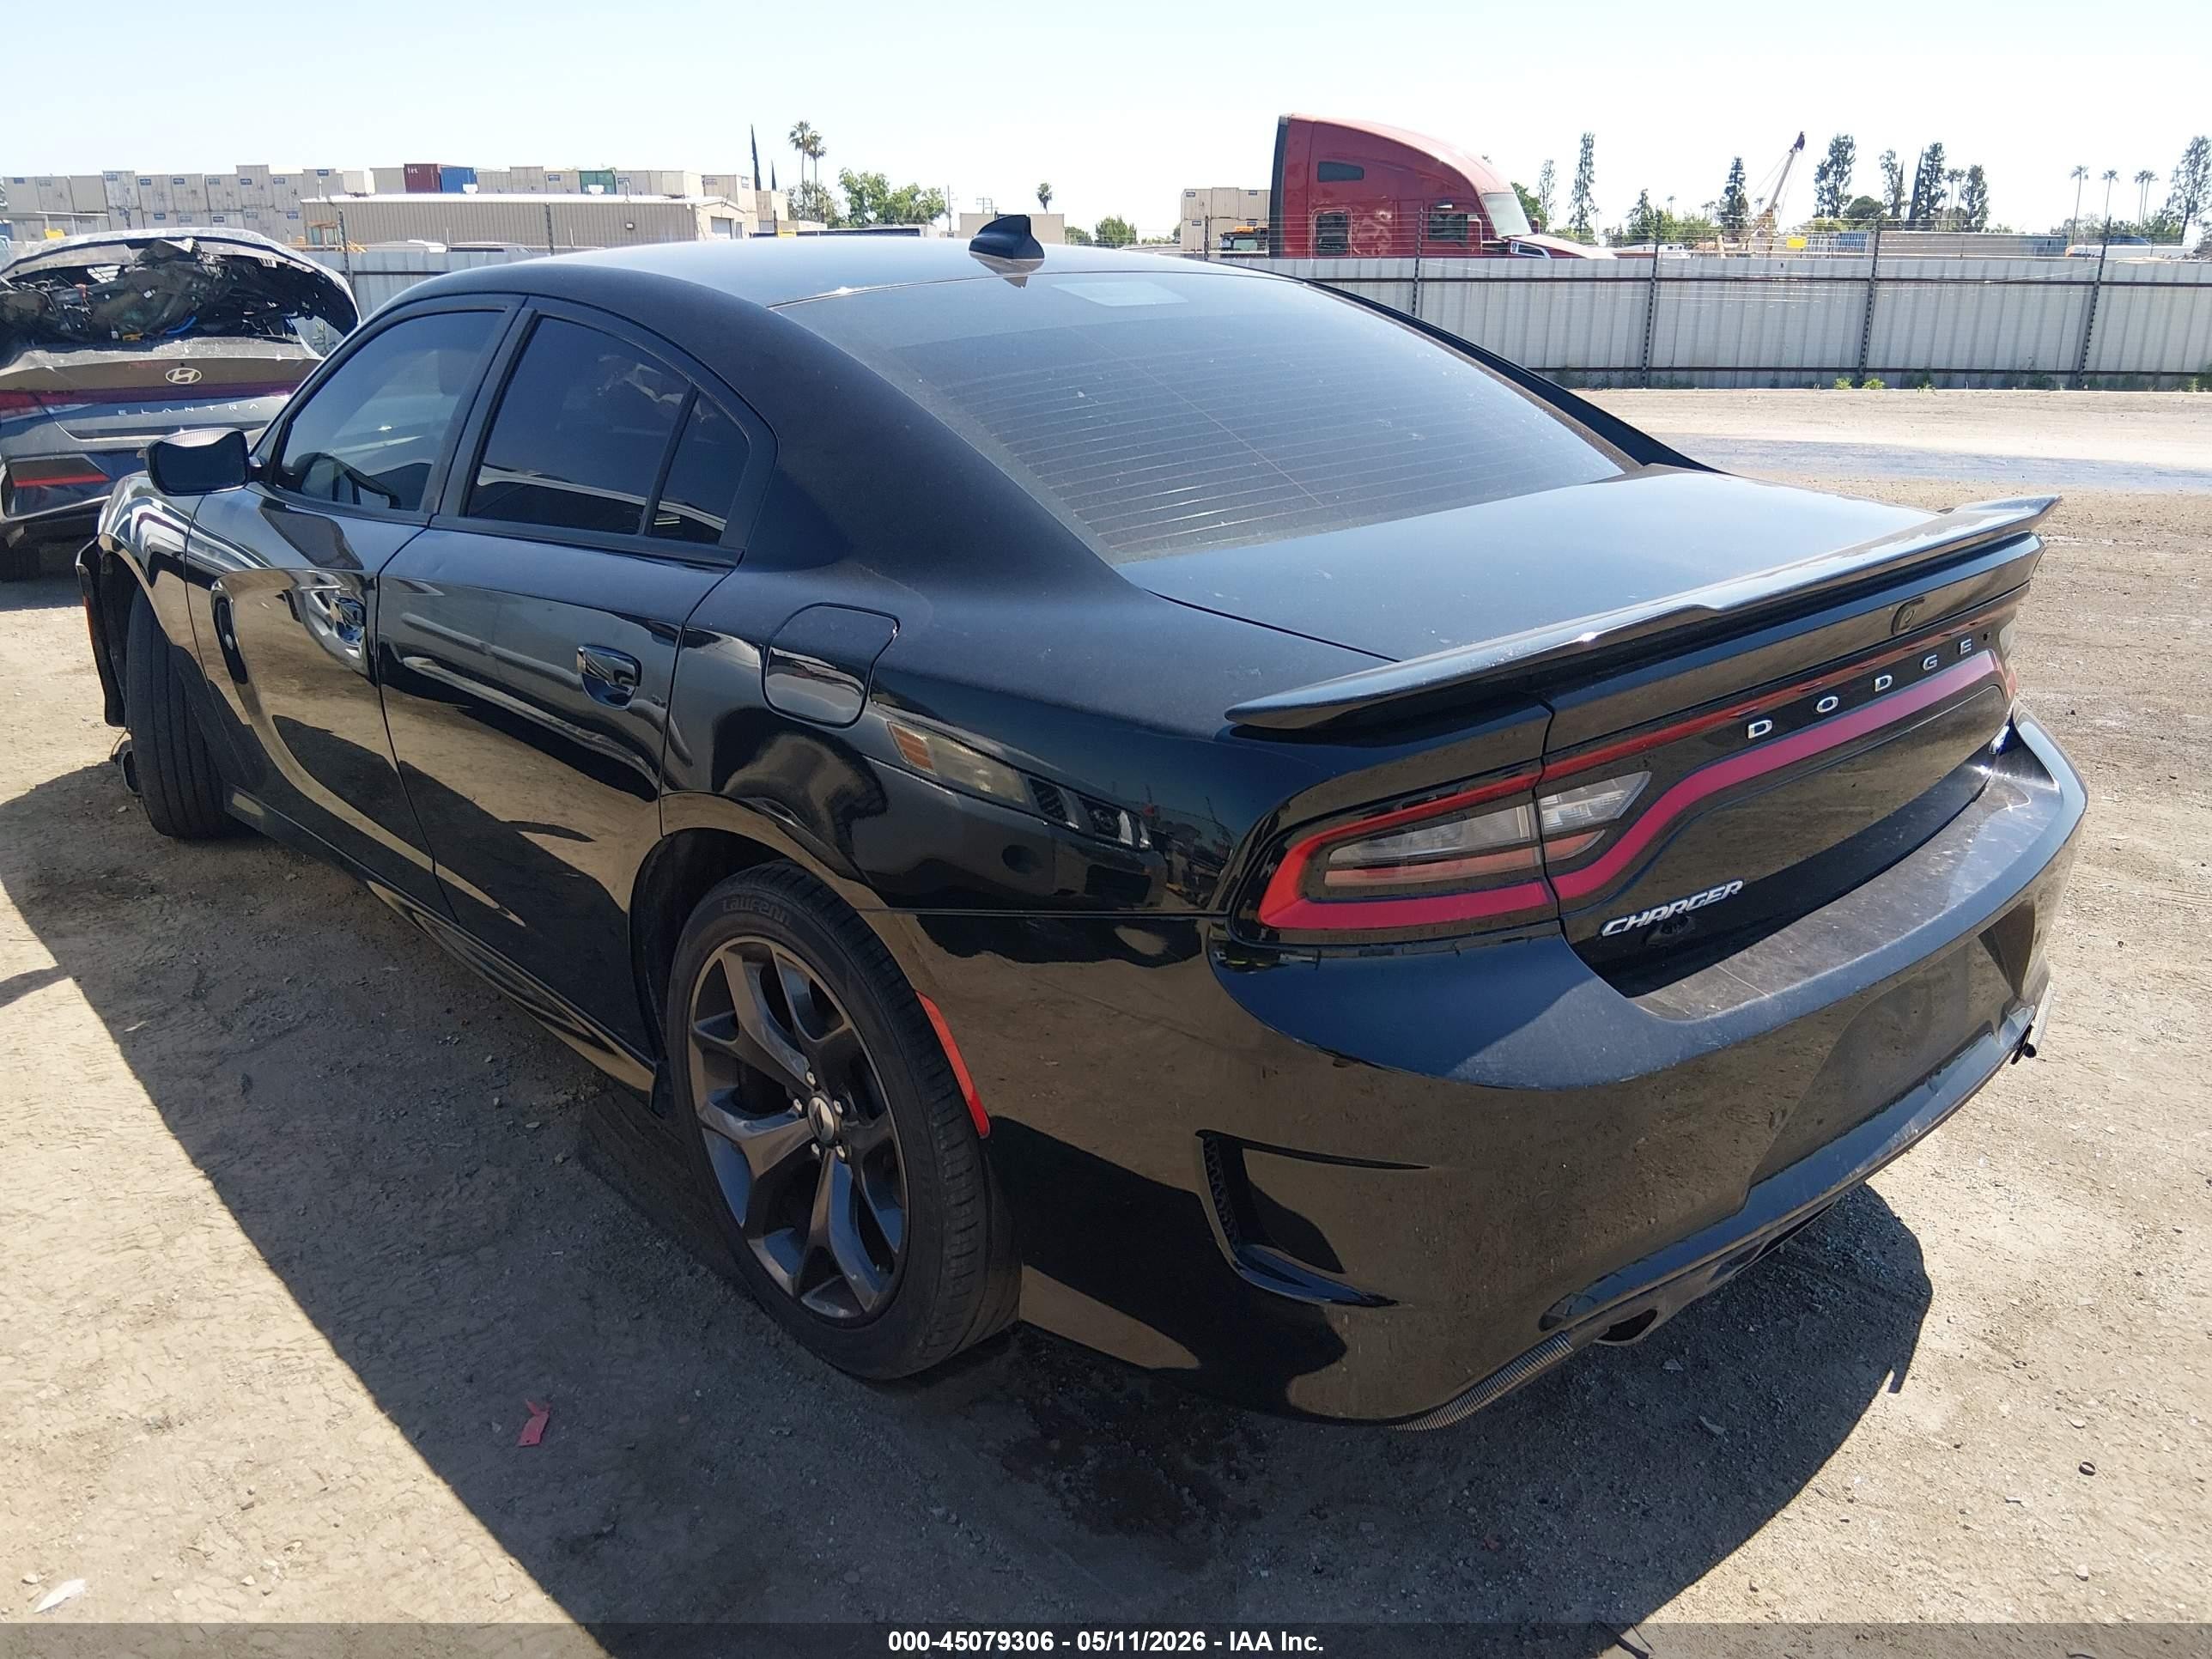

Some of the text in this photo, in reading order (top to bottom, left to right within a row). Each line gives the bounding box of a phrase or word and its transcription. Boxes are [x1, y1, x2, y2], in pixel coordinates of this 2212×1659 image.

[117, 403, 259, 416] ELANTRA
[1747, 638, 1973, 739] DODGE
[1601, 879, 1745, 938] CHARGER
